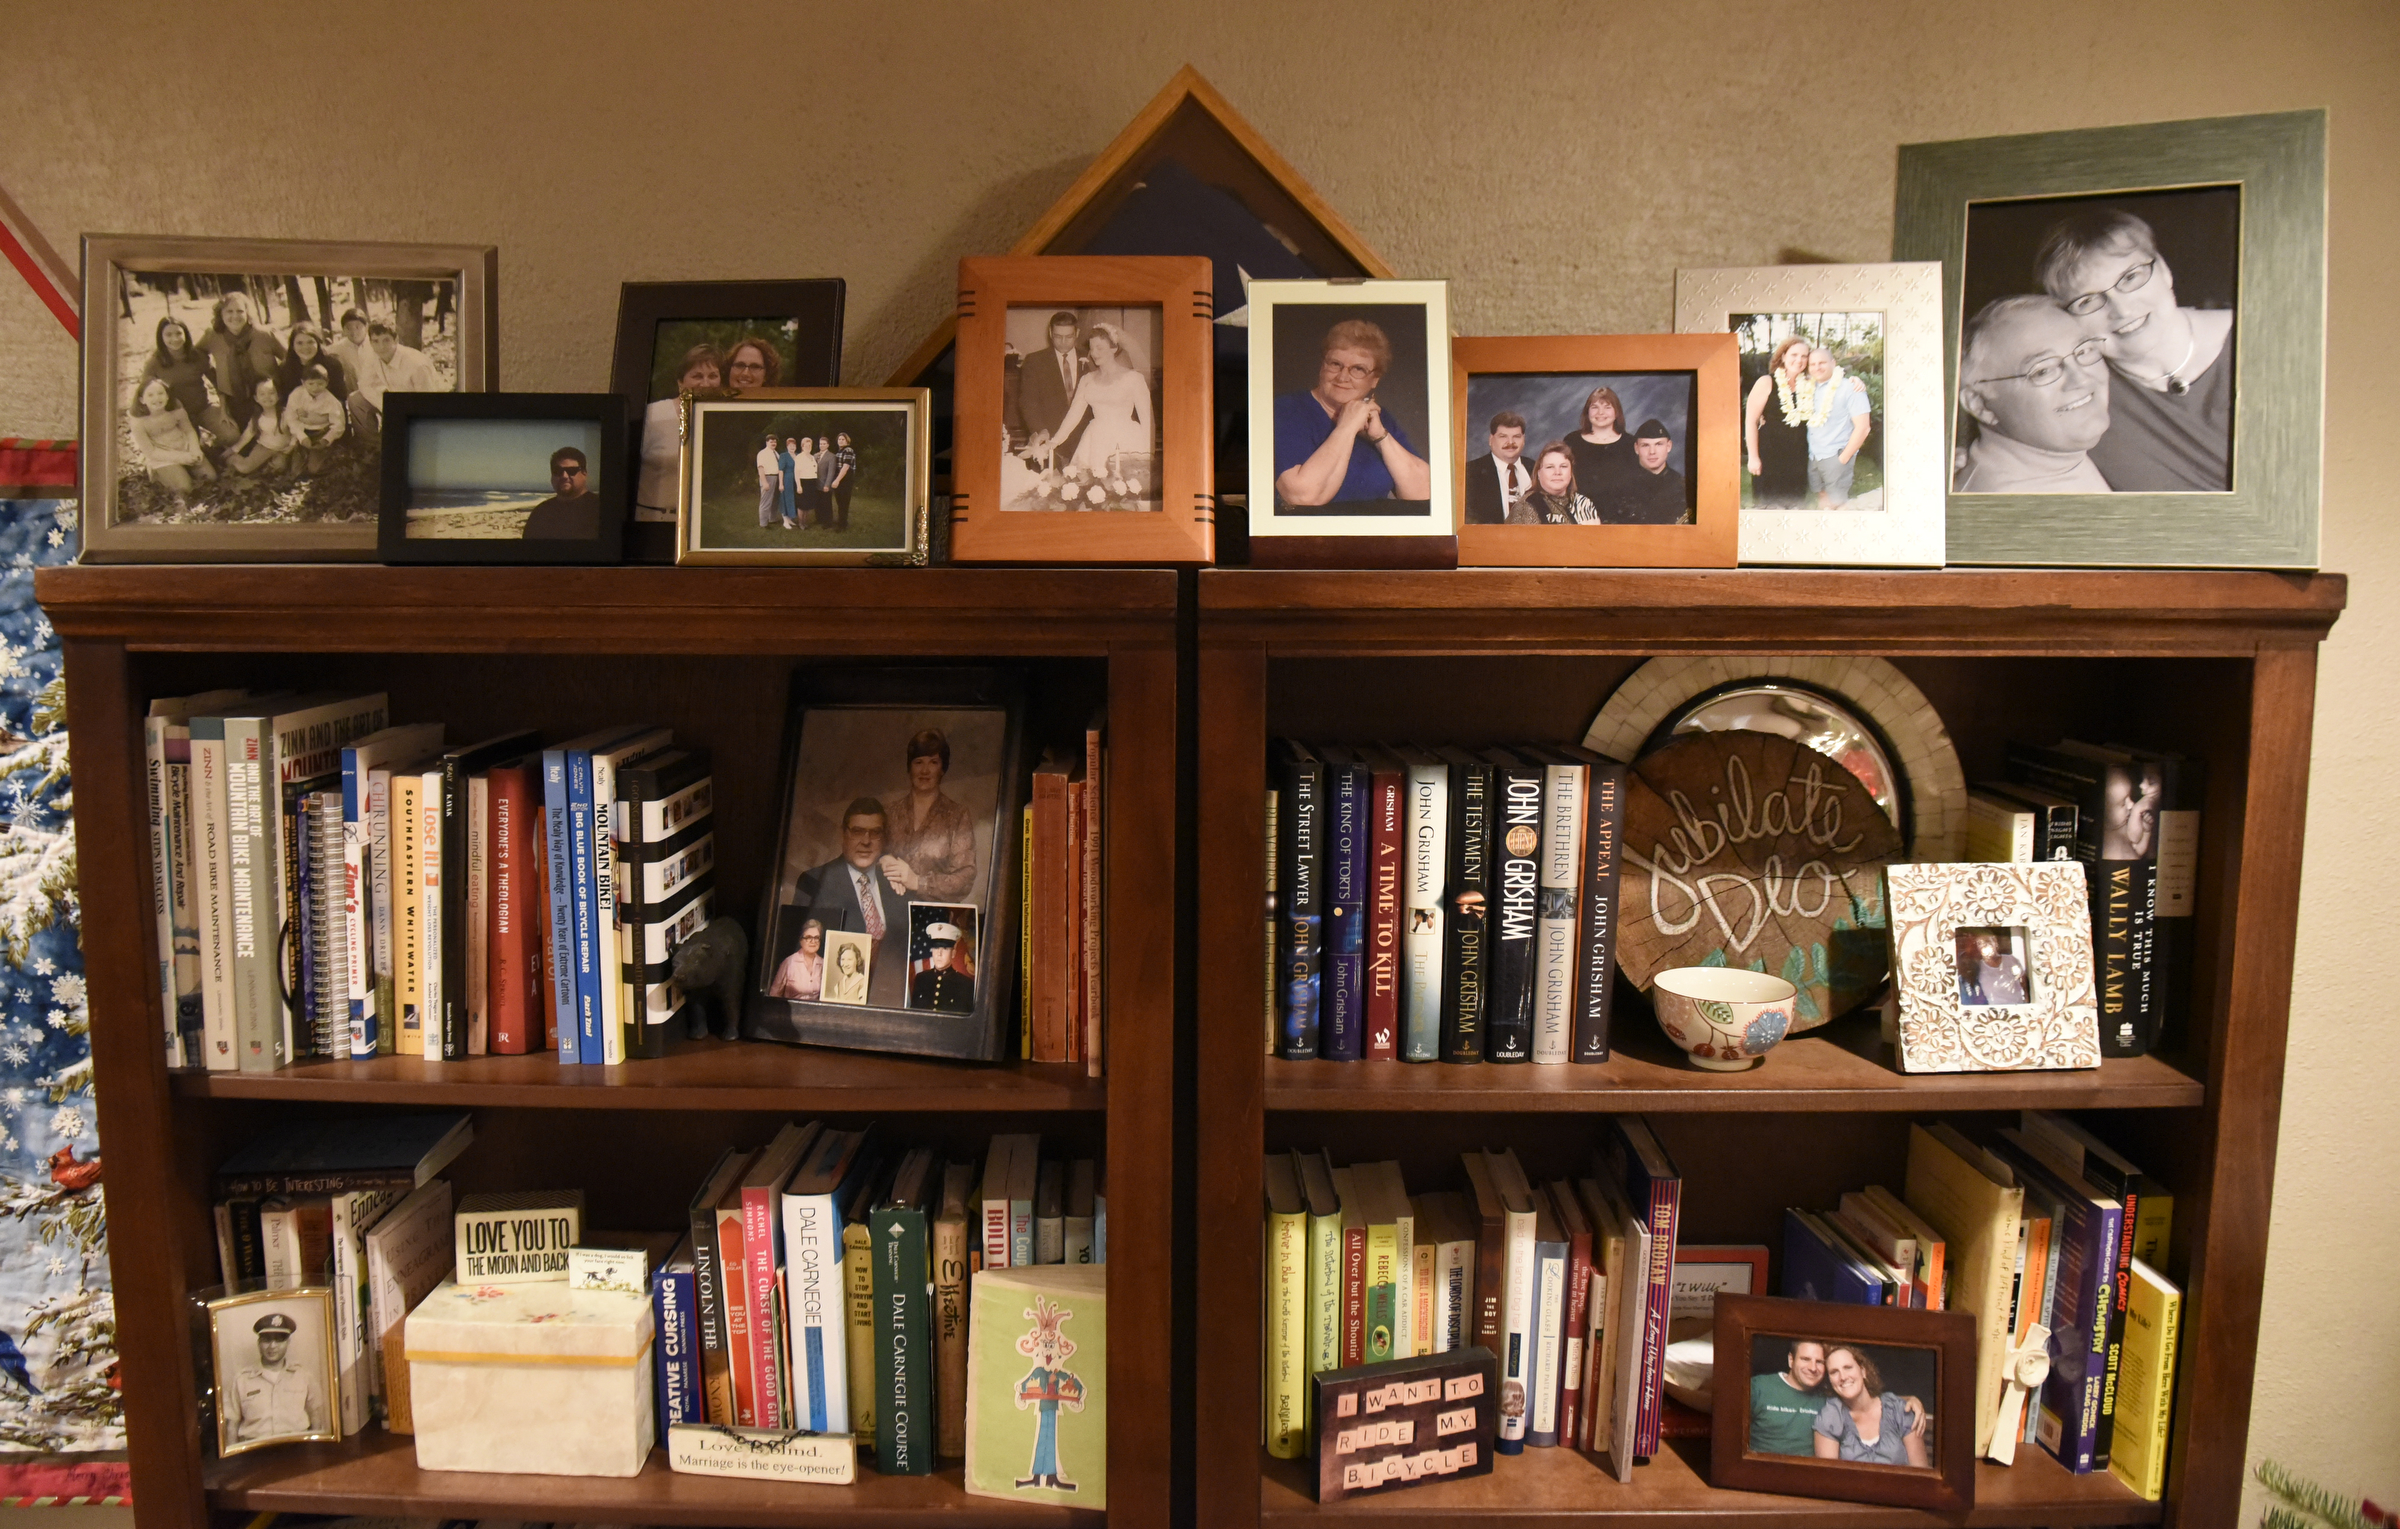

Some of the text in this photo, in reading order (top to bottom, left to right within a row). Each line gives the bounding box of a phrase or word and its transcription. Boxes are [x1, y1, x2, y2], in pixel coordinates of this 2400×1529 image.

[280, 708, 384, 759] ZINN AND THE ART OF
[246, 737, 262, 838] ZINN AND THE ART OF
[549, 765, 561, 784] Nealy
[1341, 771, 1353, 798] THE
[498, 798, 509, 859] EVERYONE'S
[551, 821, 563, 838] Nealy
[552, 807, 562, 821] The
[1339, 802, 1352, 834] KING
[424, 806, 439, 868] Lose It!
[472, 830, 482, 872] mindful
[552, 839, 564, 852] Way
[596, 803, 611, 910] MOUNTAIN BIKE!
[1339, 837, 1352, 855] OF
[229, 763, 254, 958] MOUNTAIN BIKE MAINTENANCE
[1501, 775, 1540, 941] JOHN GRISHAM
[345, 862, 359, 914] Zinn's
[406, 789, 415, 993] SOUTHEASTERN WHITEWATER
[469, 874, 481, 909] eating
[554, 861, 566, 895] Knowledge
[575, 812, 590, 974] BIG BLUE BOOK OF BICYCLE REPAIR
[1338, 858, 1351, 900] TORTS
[1368, 785, 1396, 998] GRISHAM A TIME TO KILL
[498, 872, 509, 934] THEOLOGIAN
[556, 904, 567, 926] Twenty
[1292, 771, 1315, 1030] THE STREET LAWYER JOHN GRISHAM
[1457, 774, 1484, 1034] THE TESTAMENT JOHN GRISHAM
[1545, 772, 1574, 1034] THE BRETHREN JOHN GRISHAM
[1588, 778, 1615, 1019] THE APPEAL JOHN GRISHAM
[1696, 854, 1858, 953] Deo
[557, 927, 568, 944] Years
[2104, 866, 2131, 1014] WALLY LAMB
[2132, 911, 2144, 970] IS TRUE
[558, 951, 570, 978] Extreme
[1336, 960, 1349, 987] John
[560, 978, 571, 1006] Cartoons
[1335, 988, 1349, 1035] Grisham
[466, 1218, 570, 1255] LOVE YOU TO
[745, 1201, 755, 1242] SIMMONS
[756, 1204, 766, 1239] RACHEL
[799, 1207, 818, 1246] DALE
[987, 1208, 1004, 1256] BOLD
[757, 1249, 768, 1272] THE
[1649, 1202, 1672, 1286] TOM BROKAW
[2116, 1194, 2138, 1313] UNDERSTANDING COMICS
[467, 1252, 570, 1277] THE MOON AND BACK
[855, 1266, 868, 1274] HOW
[858, 1275, 866, 1283] TO
[1377, 1254, 1390, 1291] REBECCA
[697, 1245, 718, 1350] LINCOLN THE
[758, 1278, 771, 1315] CURSE
[801, 1249, 822, 1324] CARNEGIE
[855, 1284, 869, 1292] STOP
[939, 1258, 964, 1343] Effective
[1350, 1233, 1361, 1361] All Over but the Shoutin'
[1375, 1291, 1388, 1320] WELLS
[661, 1277, 679, 1357] CURSING
[762, 1319, 771, 1335] OF
[854, 1310, 871, 1318] START
[854, 1318, 872, 1327] LIVING
[1446, 1265, 1463, 1351] THE LORDS OF DISCIPLIN
[763, 1338, 774, 1361] THE
[1643, 1306, 1661, 1411] A Long Way from Home
[765, 1367, 775, 1398] GOOD
[892, 1293, 909, 1470] DALE CARNEGIE COURSE
[1368, 1384, 1435, 1408] WANT
[1450, 1379, 1479, 1395] TO
[2102, 1342, 2120, 1416] SCOTT McCLOUD
[768, 1403, 778, 1429] GIRL
[1339, 1414, 1469, 1449] RIDE MY
[2088, 1399, 2098, 1429] GONICK
[679, 1454, 846, 1476] Marriage is the eye-opener!
[1348, 1449, 1471, 1483] BICYCLE
